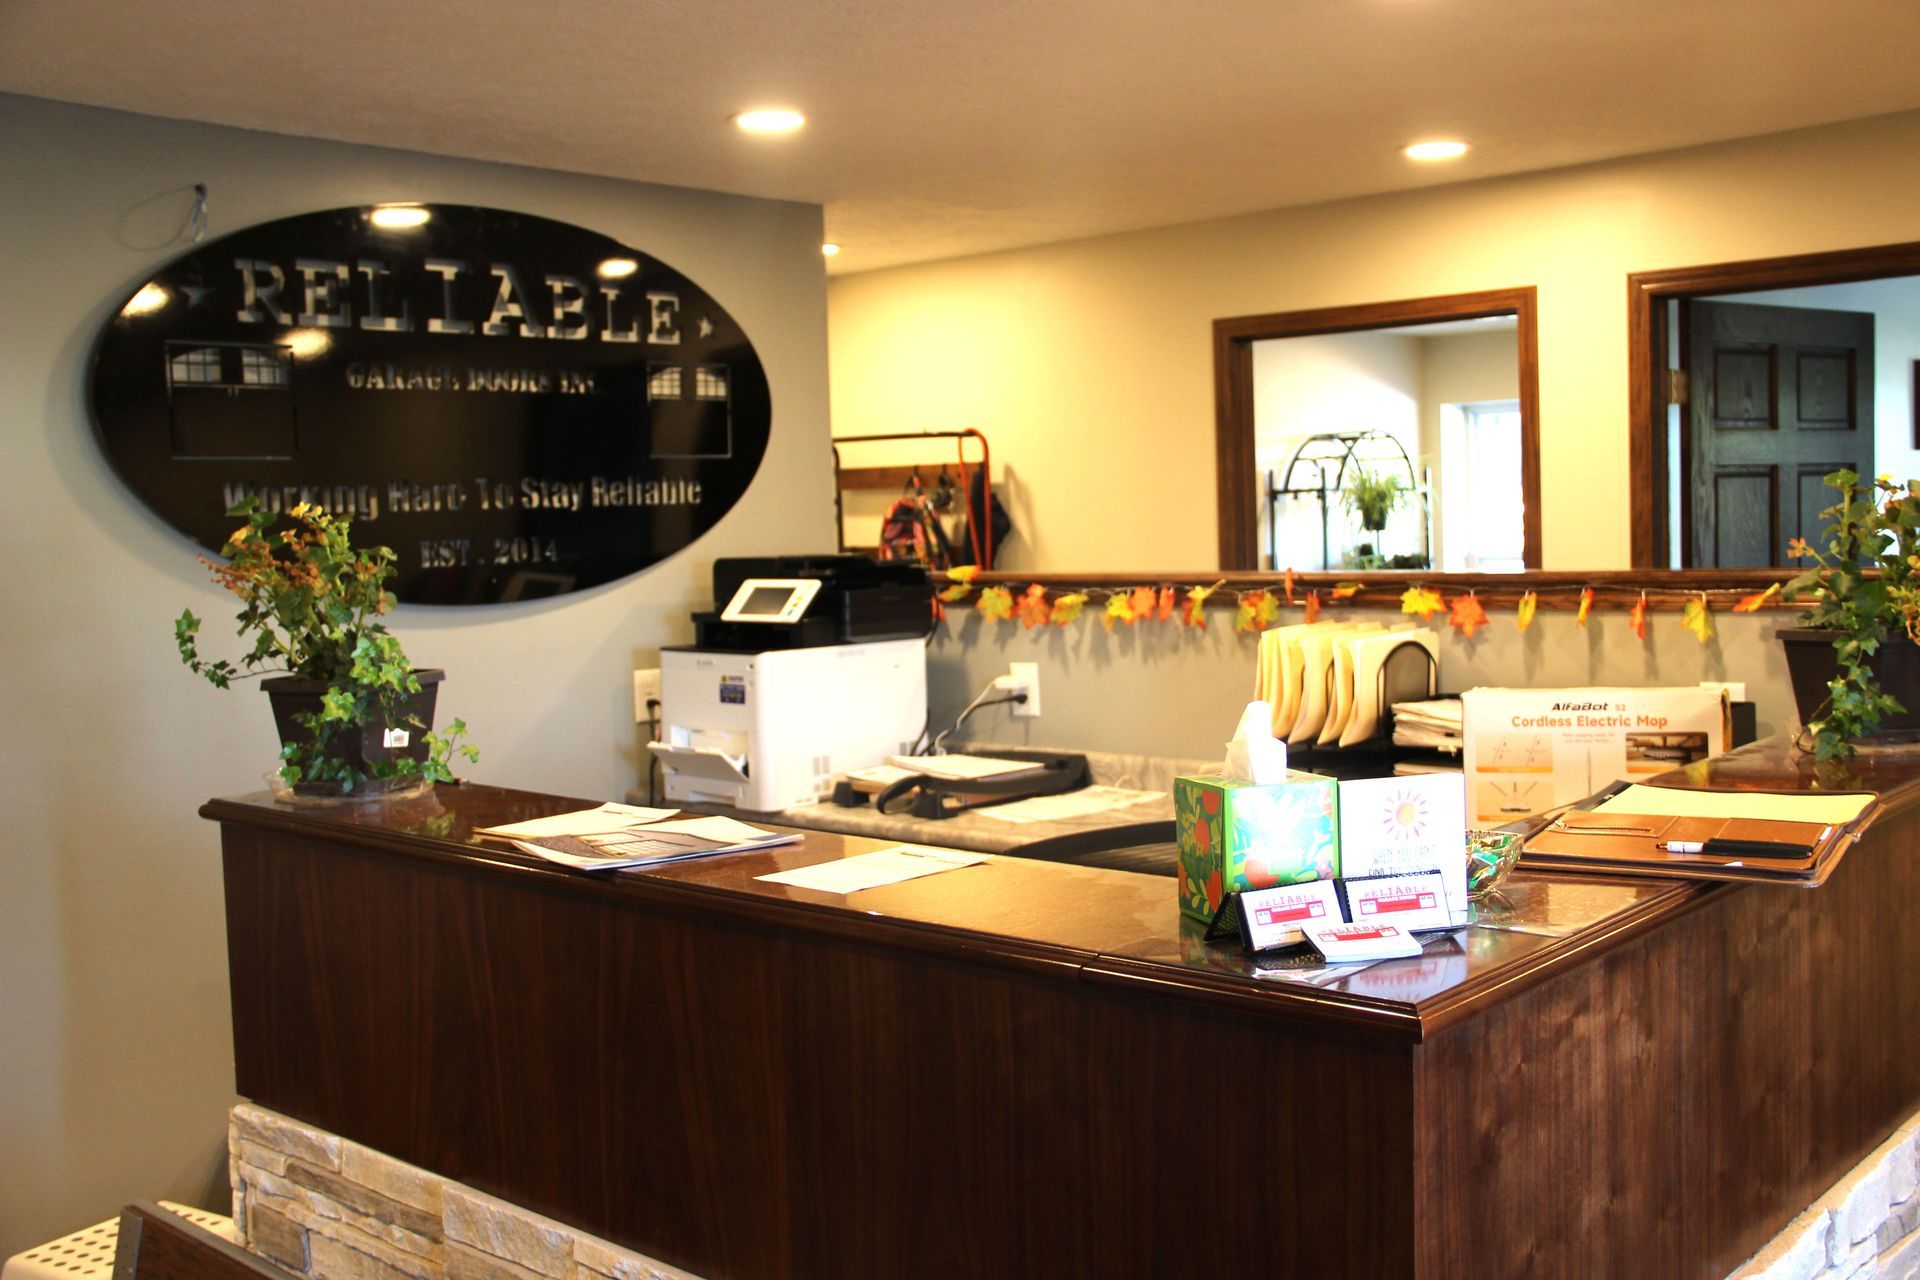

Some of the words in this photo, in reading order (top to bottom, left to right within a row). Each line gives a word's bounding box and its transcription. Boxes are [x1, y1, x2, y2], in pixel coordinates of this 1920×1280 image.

[235, 257, 681, 345] RELIABLE
[223, 481, 379, 521] Working
[387, 478, 468, 512] Hard
[475, 477, 514, 511] To
[520, 477, 583, 512] Stay
[590, 475, 703, 508] Reliable
[494, 536, 558, 565] 2014
[1551, 702, 1609, 712] AlfaBot
[1511, 715, 1573, 728] Cordless
[1576, 714, 1632, 728] Electric
[1636, 715, 1668, 730] Mop
